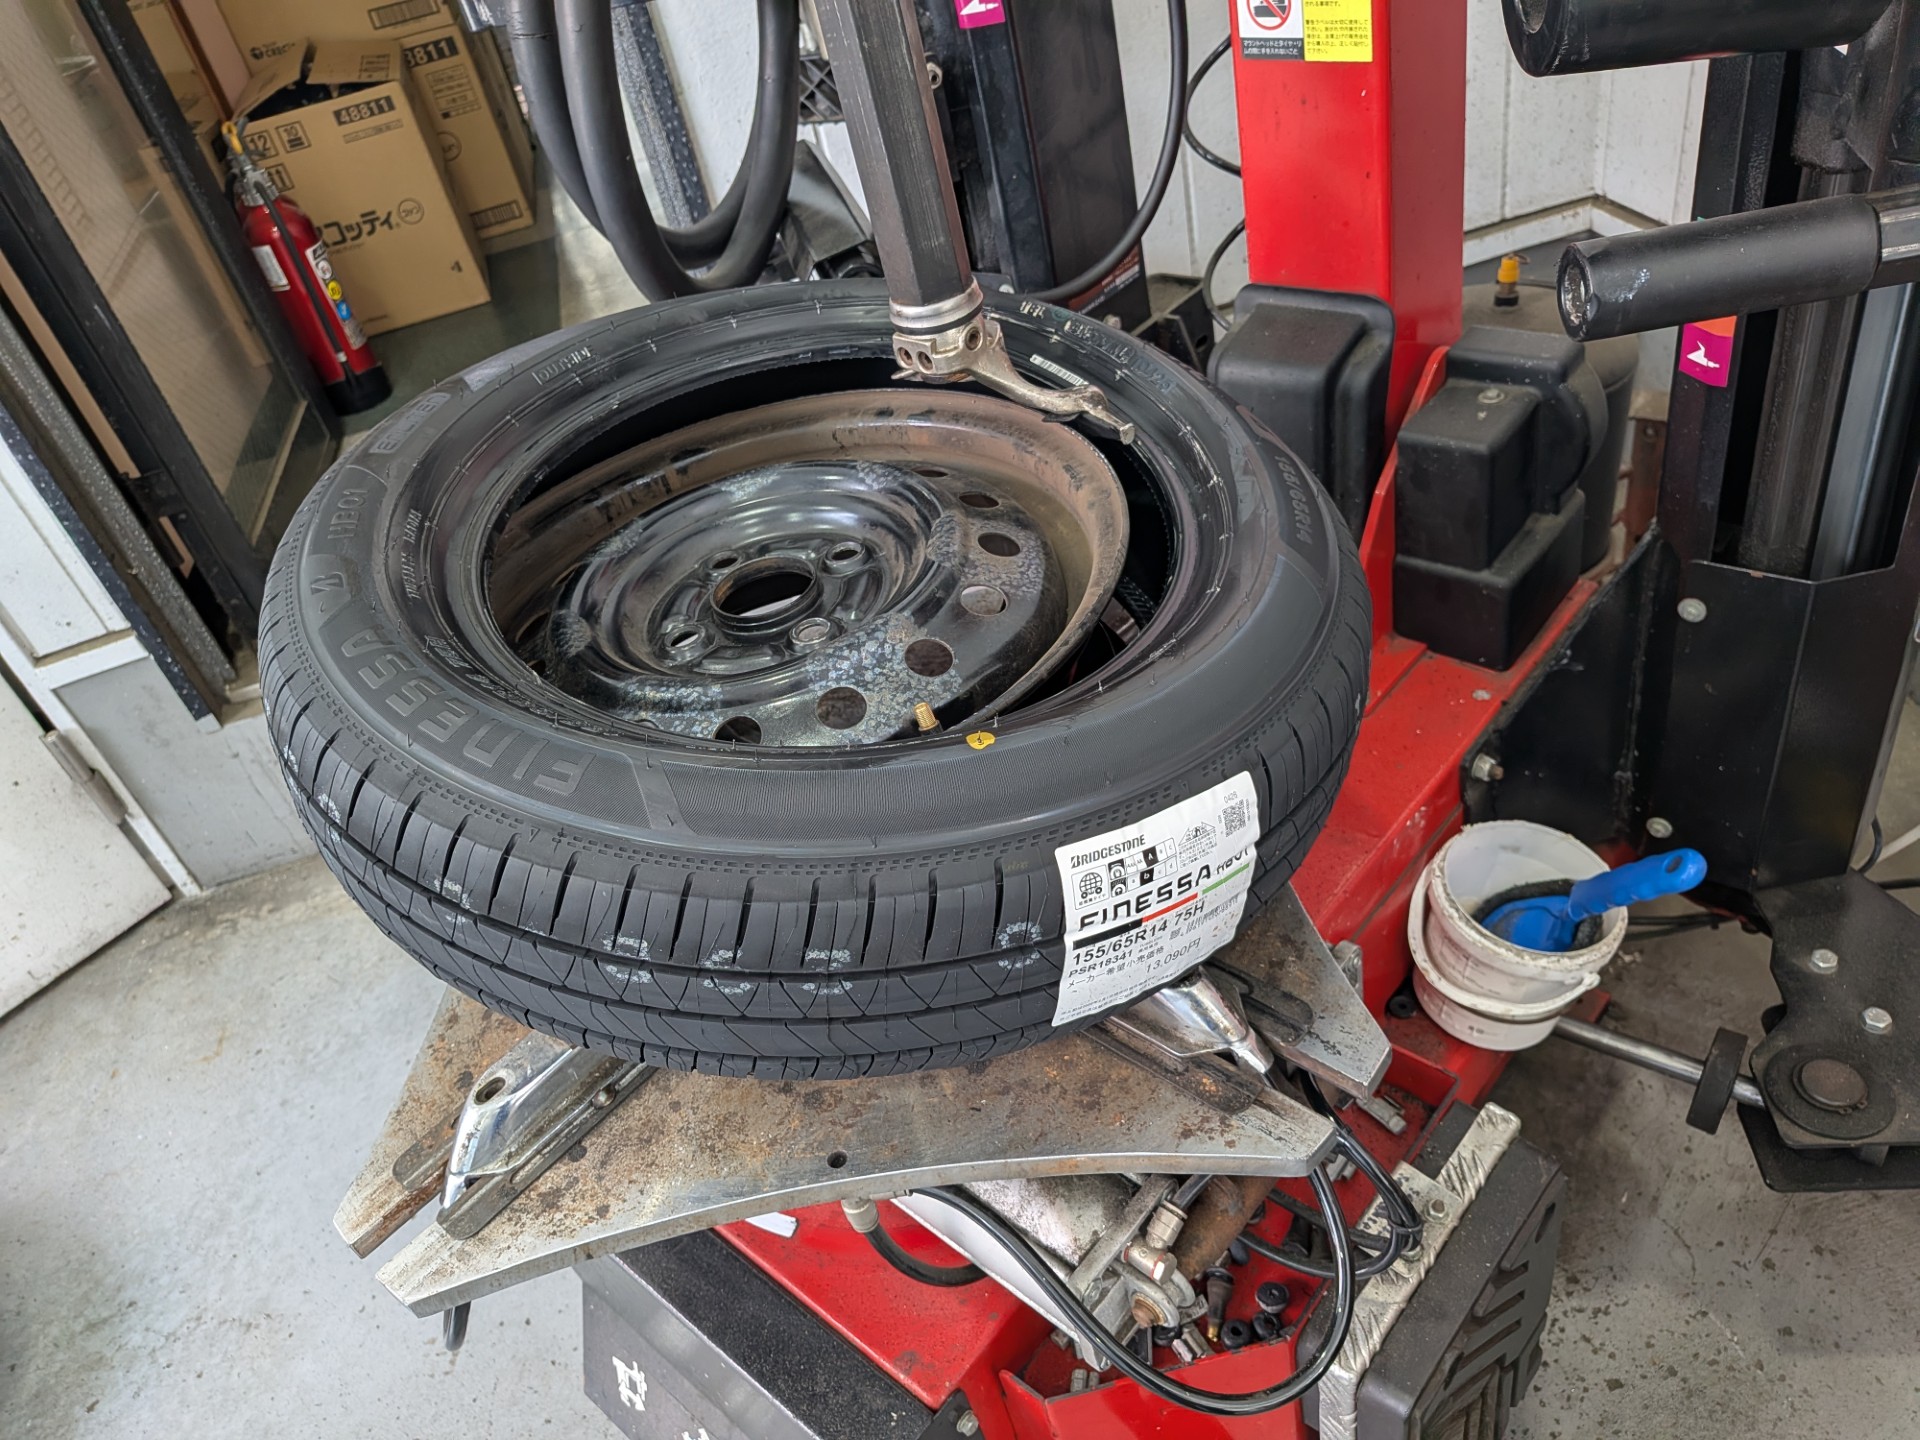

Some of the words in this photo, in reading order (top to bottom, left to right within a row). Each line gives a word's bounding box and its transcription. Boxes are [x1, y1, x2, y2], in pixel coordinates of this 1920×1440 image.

[404, 39, 453, 67] 8811
[338, 97, 391, 125] 48811
[329, 487, 369, 540] HB01
[1274, 455, 1313, 545] 155/65R14
[341, 626, 600, 796] FINESSA
[1070, 833, 1147, 869] BRIDGESTONE
[1078, 863, 1211, 932] FINESSA
[1071, 919, 1169, 966] 155/65R14
[1174, 900, 1206, 927] 75H
[1067, 949, 1134, 978] PSR18341
[1067, 944, 1166, 989] メーカー希望小売価格
